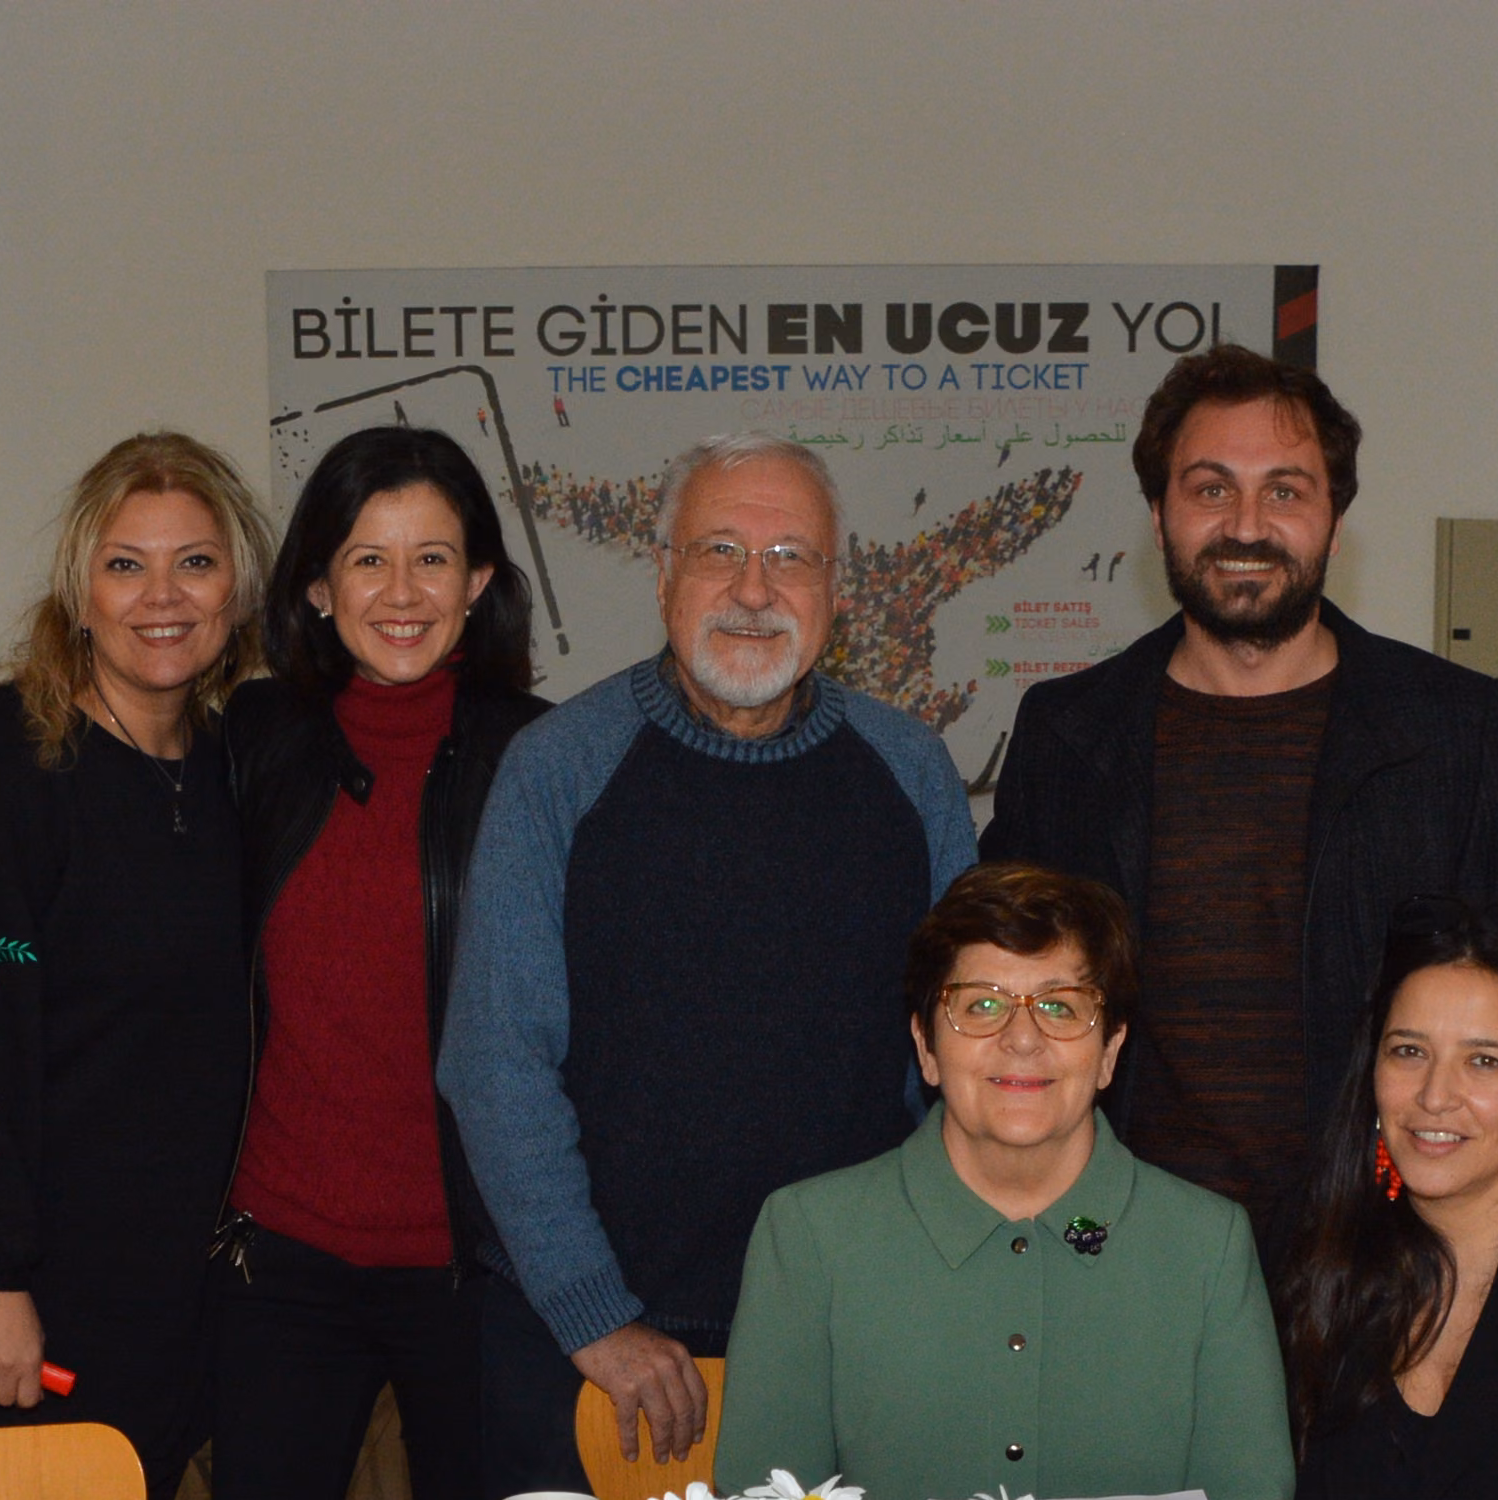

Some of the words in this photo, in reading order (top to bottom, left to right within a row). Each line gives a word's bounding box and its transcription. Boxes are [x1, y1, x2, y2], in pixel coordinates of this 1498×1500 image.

[293, 296, 515, 359] BİLETE
[537, 294, 748, 357] GİDEN
[767, 303, 863, 355] EN
[886, 302, 1089, 354] UCUZ
[547, 366, 607, 393] THE
[616, 365, 792, 393] CHEAPEST
[803, 364, 872, 391] WAY
[881, 364, 928, 390] TO
[937, 364, 961, 390] A
[970, 363, 1090, 390] TICKET
